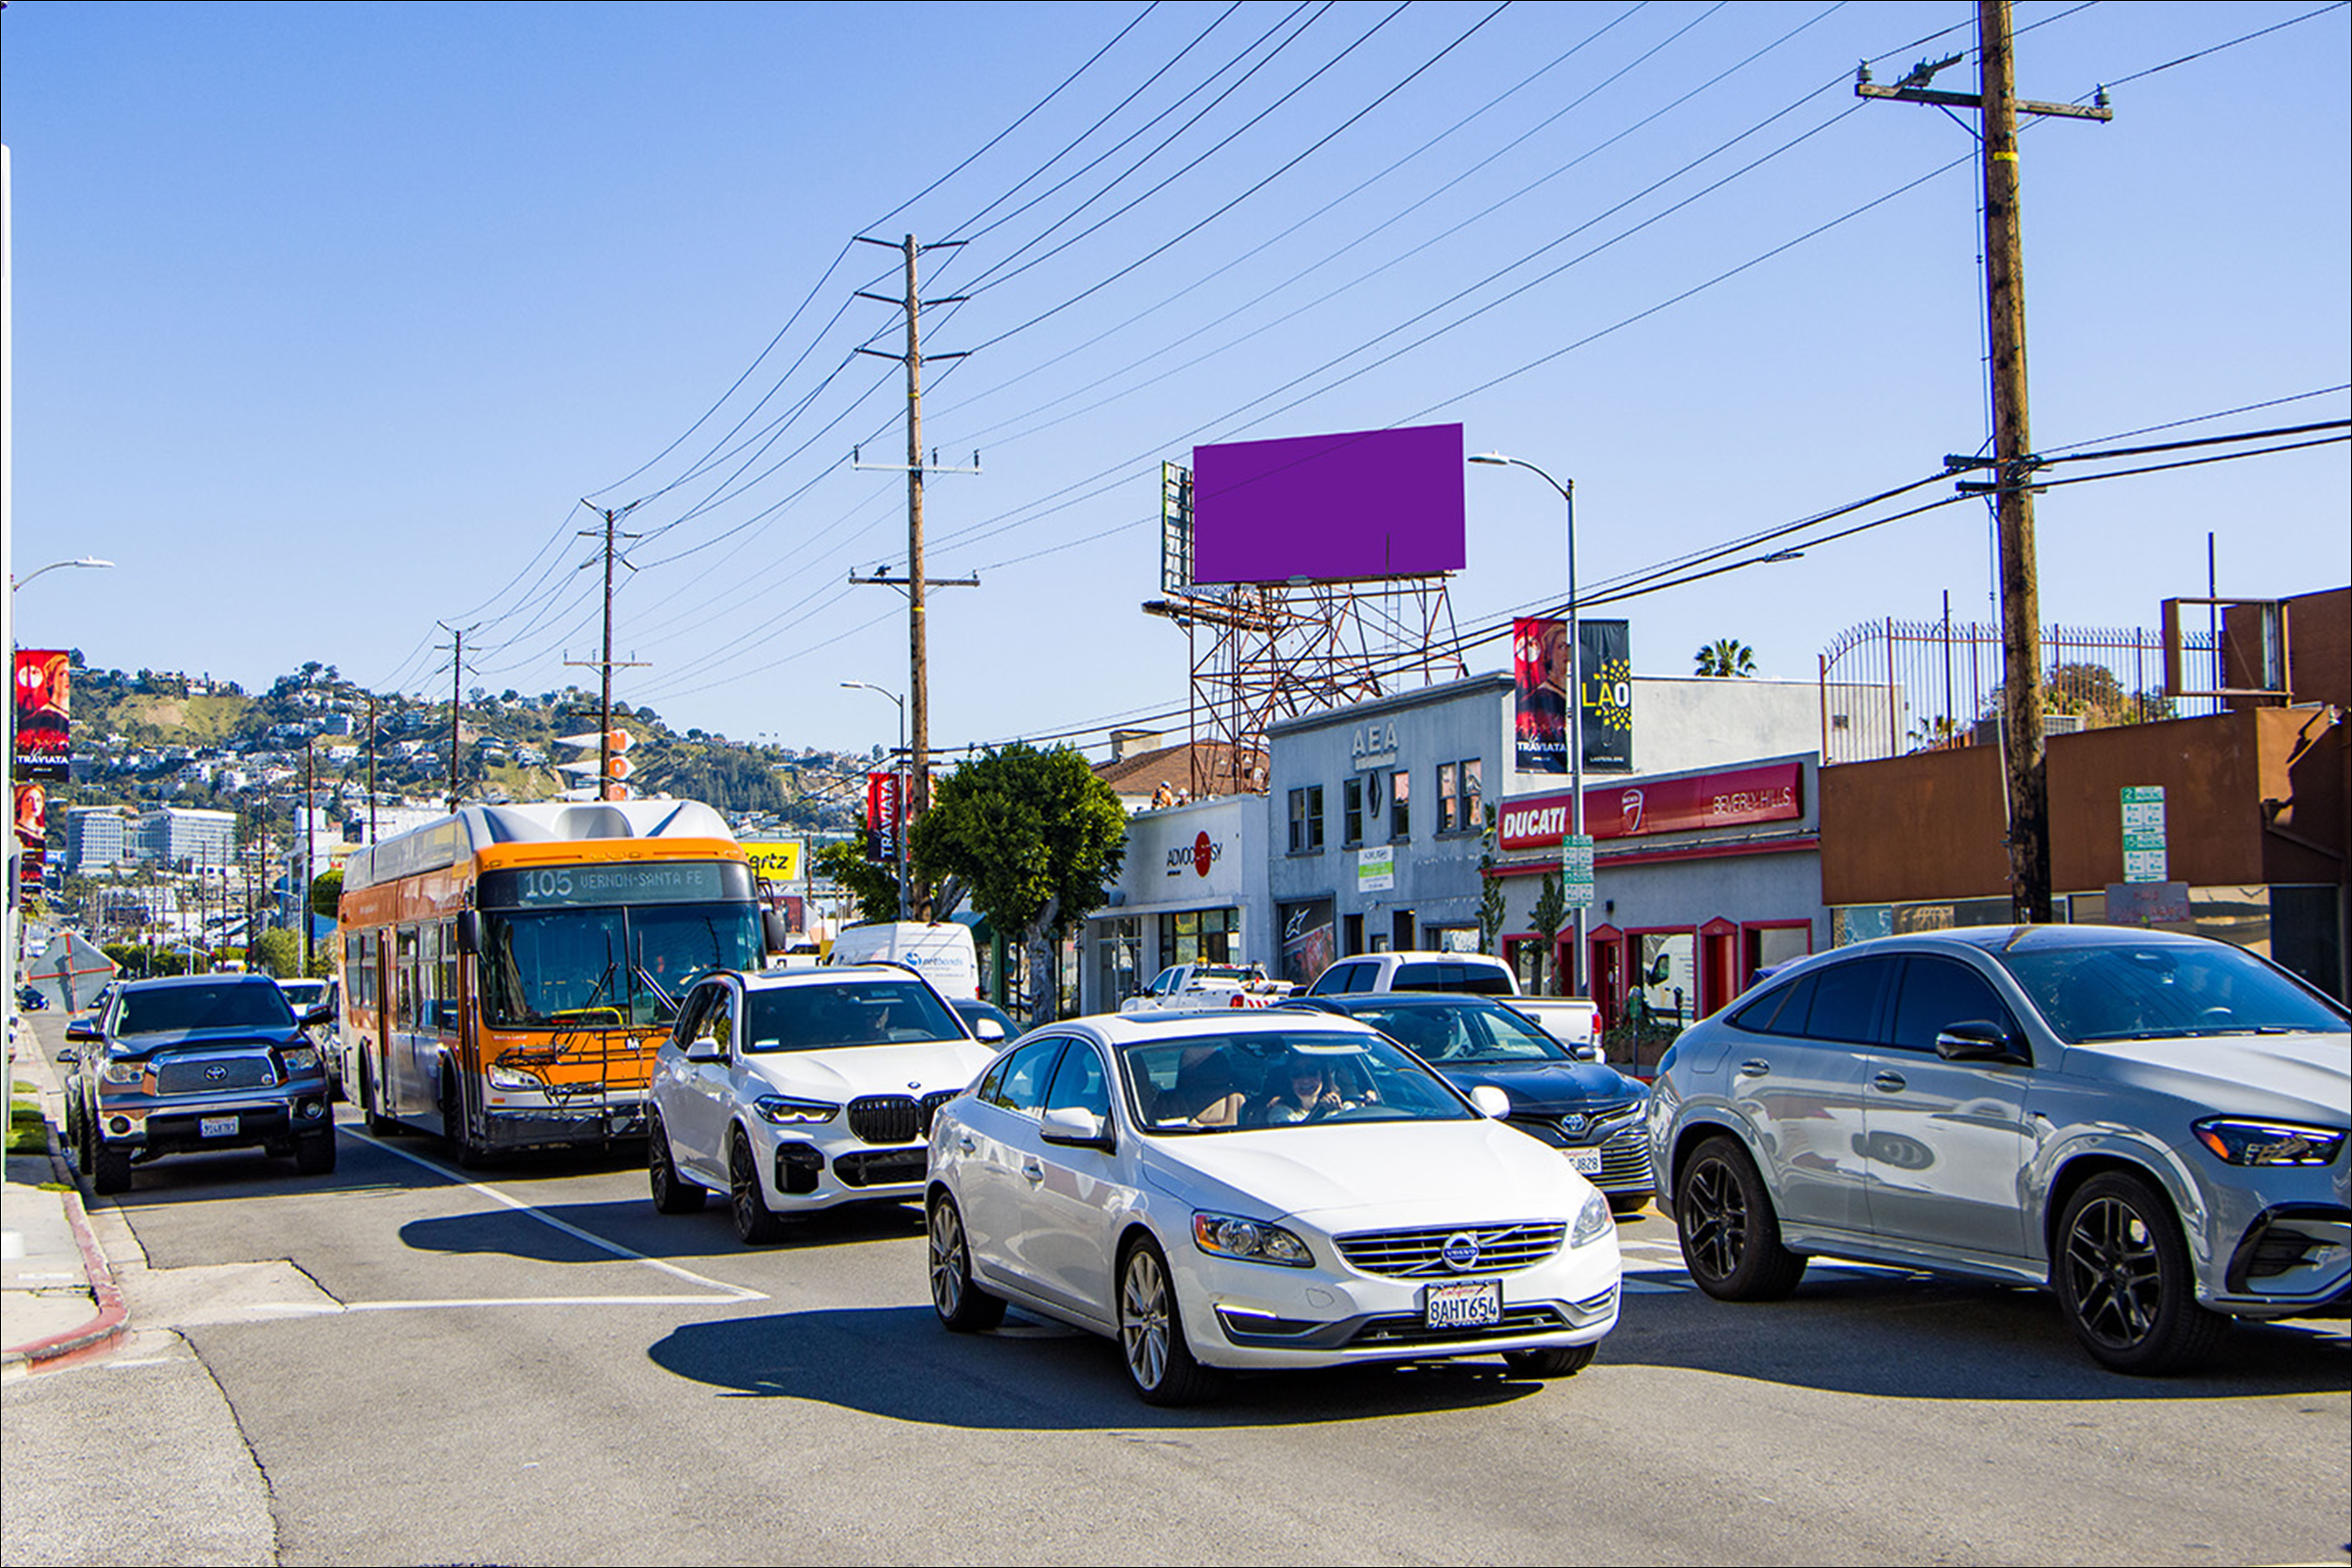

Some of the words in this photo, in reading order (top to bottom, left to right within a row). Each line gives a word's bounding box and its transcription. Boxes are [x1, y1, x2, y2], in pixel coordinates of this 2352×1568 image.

[1582, 682, 1630, 707] LAO
[1351, 722, 1398, 756] AEA
[1516, 742, 1567, 752] TRAVIATA
[17, 755, 69, 764] TRAVIATA
[1714, 792, 1759, 815] BEVERLY
[1760, 786, 1790, 808] HILLS
[881, 779, 893, 858] TRAVIATA
[1503, 807, 1566, 839] DUCATI
[746, 853, 789, 869] ertz
[525, 870, 573, 898] 105
[580, 872, 681, 889] VERNON-SANTA
[686, 870, 703, 884] FE
[1430, 1297, 1497, 1321] 8AHT654
